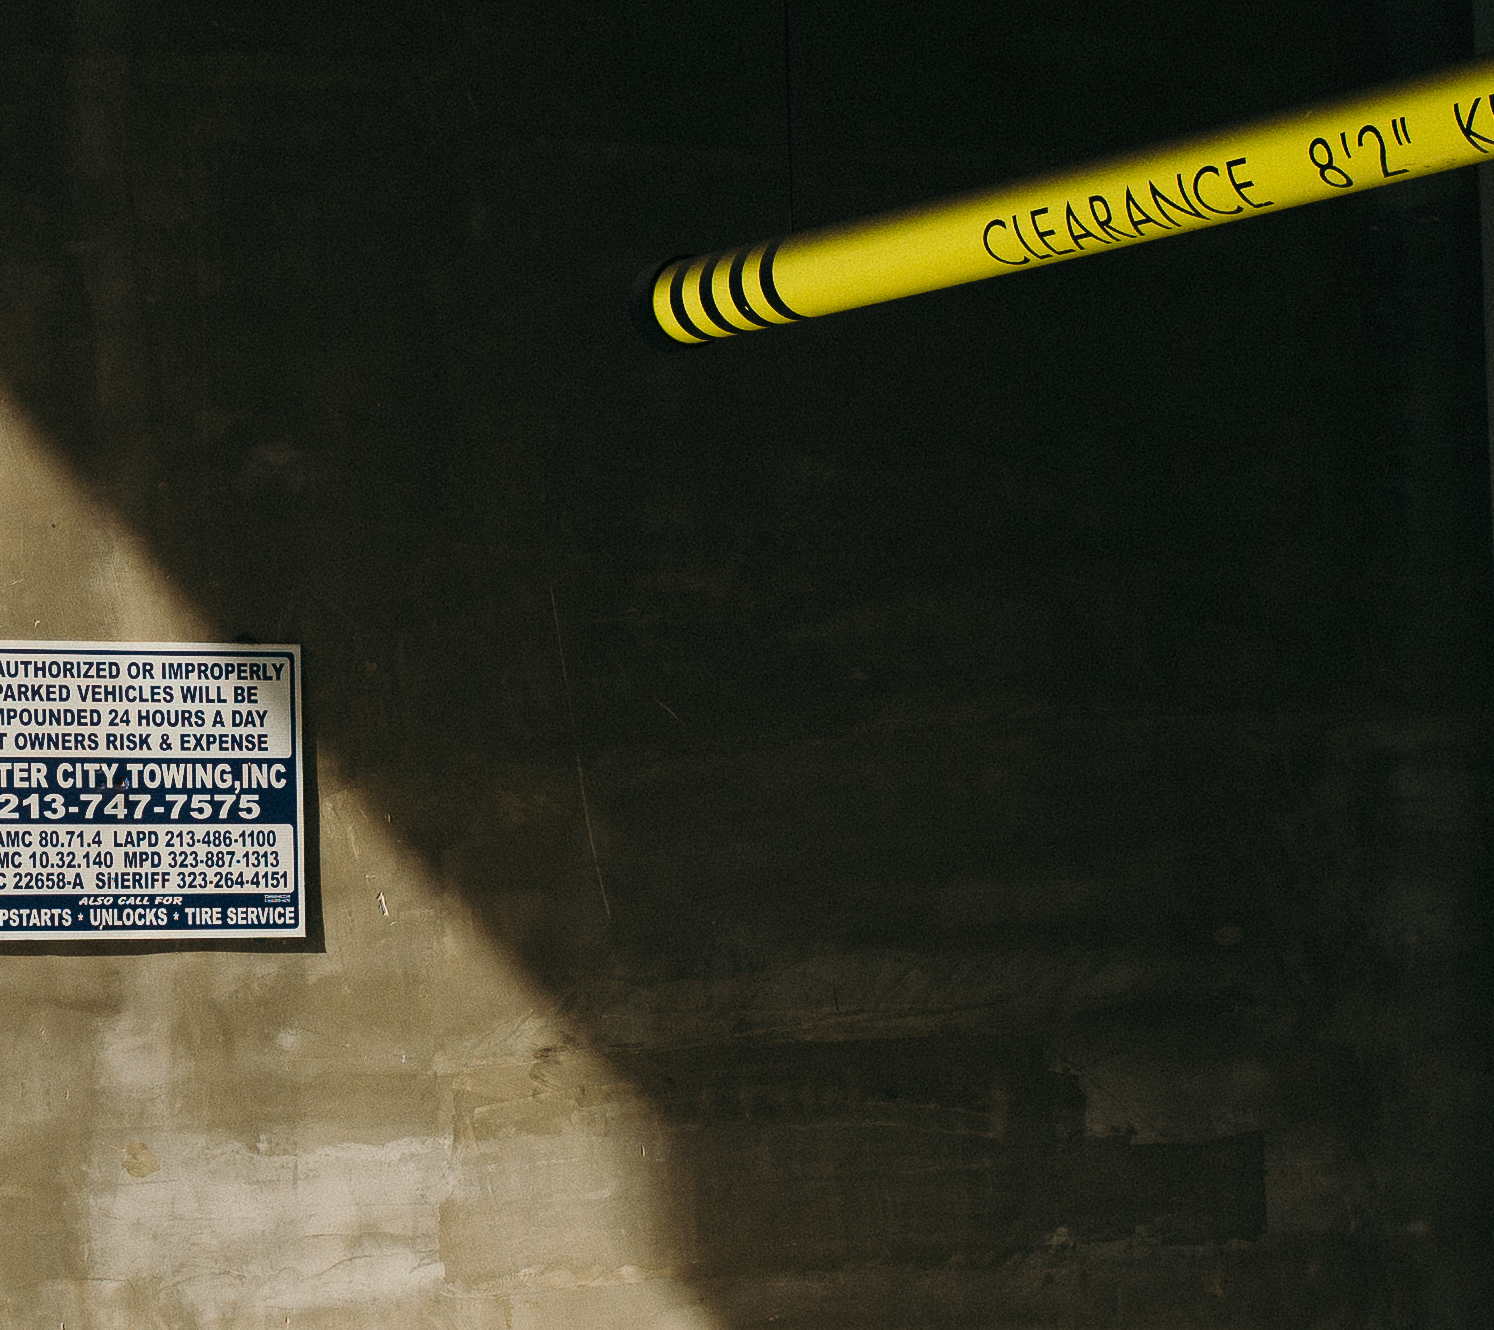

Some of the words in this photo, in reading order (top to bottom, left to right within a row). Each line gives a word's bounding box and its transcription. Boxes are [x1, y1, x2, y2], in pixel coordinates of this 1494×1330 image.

[983, 158, 1275, 265] CLEARANCE
[1308, 117, 1412, 188] 8'2"
[127, 662, 155, 679] OR
[161, 662, 284, 681] IMPROPERLY
[77, 685, 174, 703] VEHICLES
[180, 686, 227, 703] WILL
[234, 686, 258, 704] BE
[108, 709, 130, 726] 24
[138, 710, 205, 727] HOURS
[212, 710, 225, 727] A
[232, 710, 268, 727] DAY
[15, 733, 99, 750] OWNERS
[106, 733, 152, 751] RISK
[159, 734, 172, 751] &
[180, 734, 268, 751] EXPENSE
[57, 763, 118, 788] CITY
[39, 831, 102, 847] 80.71.4
[114, 831, 158, 847] LAPD
[165, 830, 276, 847] 213-486-1100
[29, 851, 113, 868] 10.32.140
[124, 851, 161, 868] MPD
[168, 851, 279, 868] 323-887-1313
[13, 872, 84, 889] 22658-A
[96, 872, 170, 889] SHERIFF
[177, 871, 287, 889] 323-264-4151
[79, 897, 113, 905] ALSO
[118, 897, 149, 905] CALL
[155, 897, 182, 905] FOR
[90, 908, 167, 927] UNLOCKS
[185, 908, 222, 925] TIRE
[227, 907, 294, 924] SERVICE
